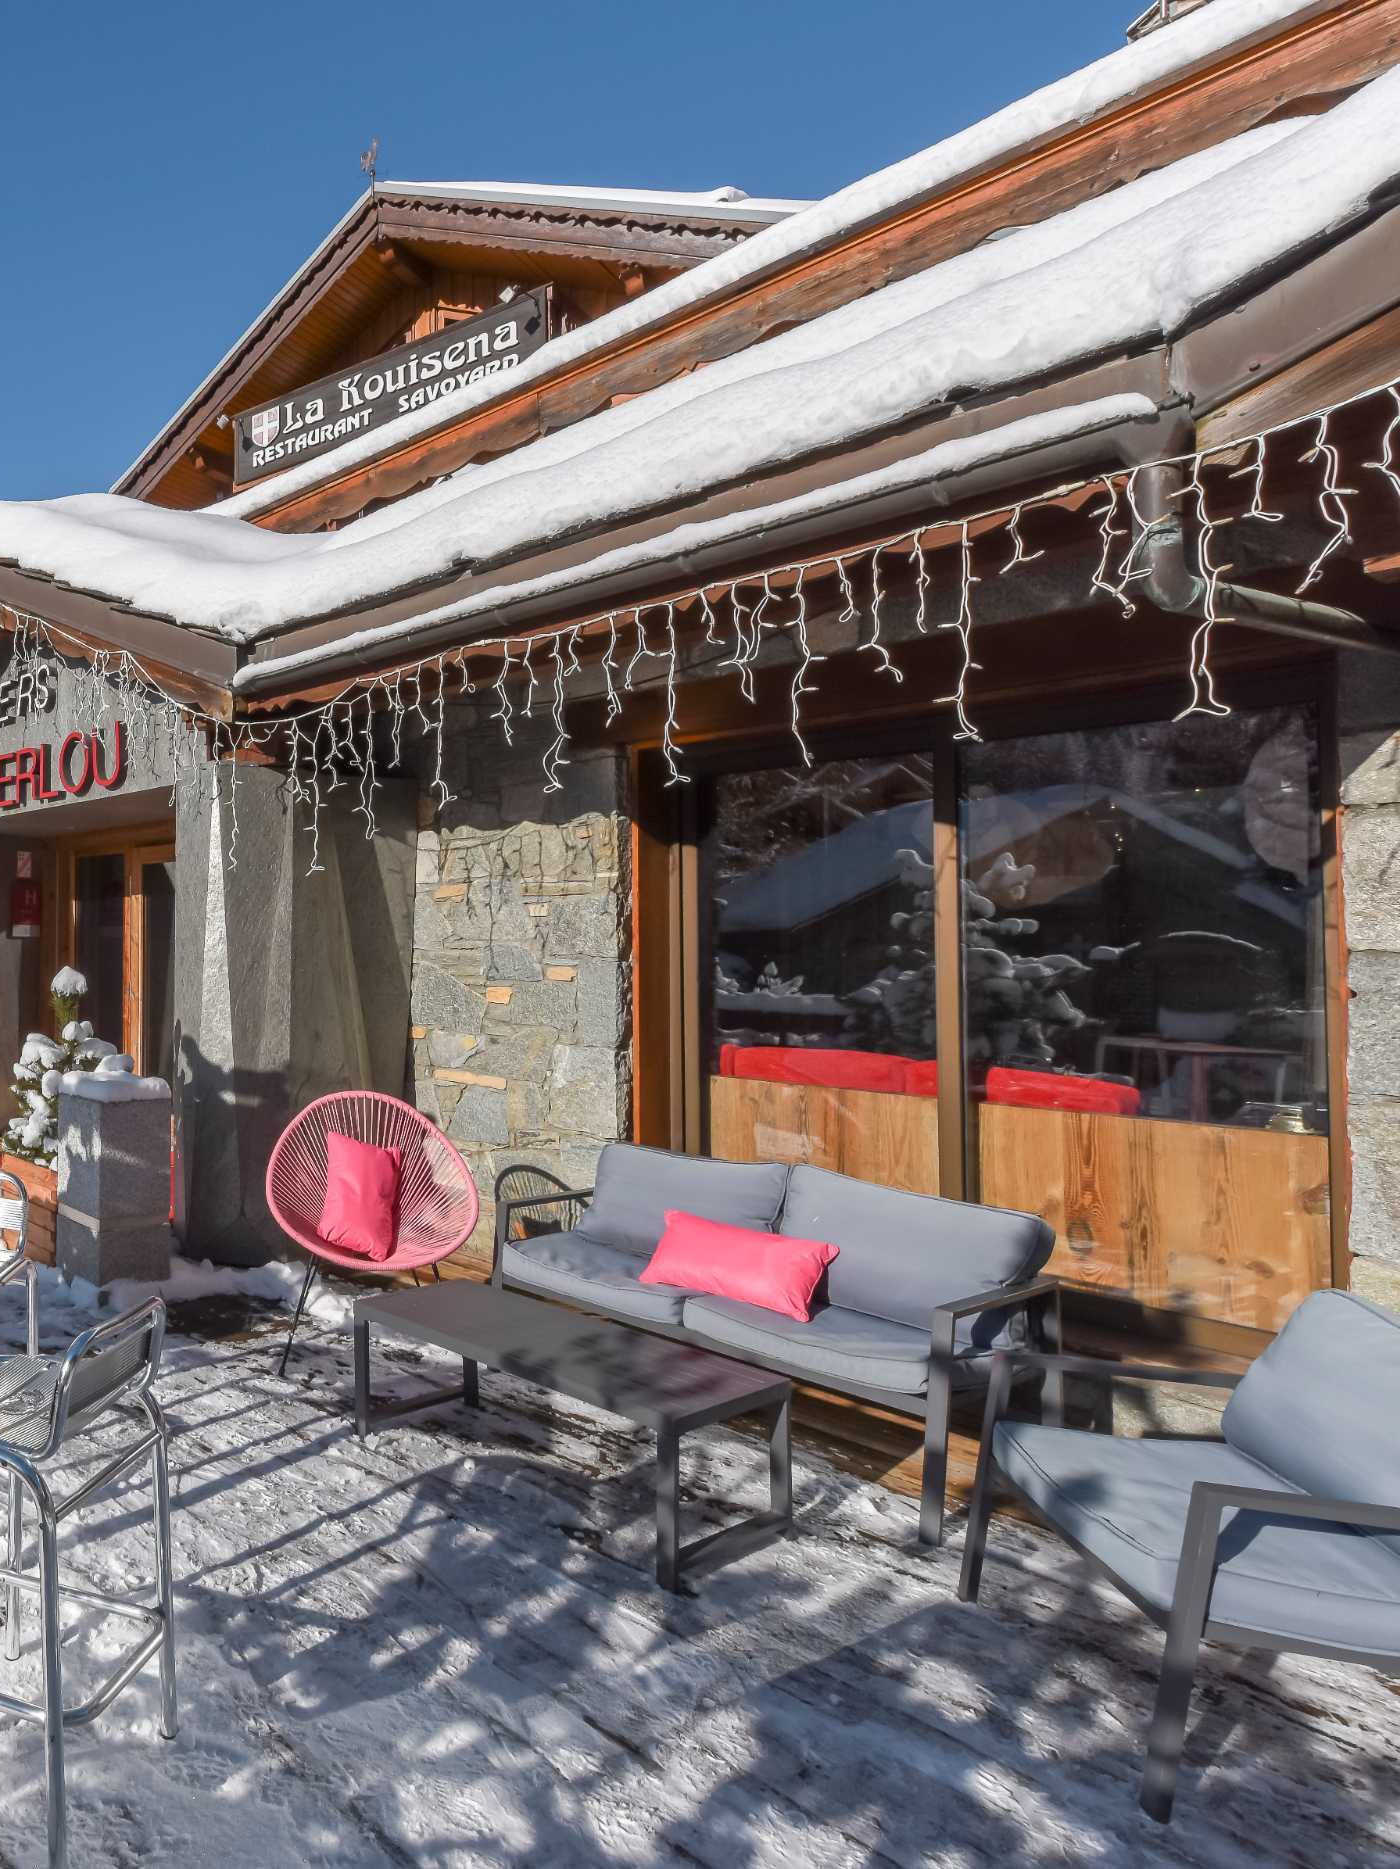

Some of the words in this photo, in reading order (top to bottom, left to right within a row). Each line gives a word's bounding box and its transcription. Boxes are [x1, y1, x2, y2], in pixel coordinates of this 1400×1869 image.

[283, 398, 325, 434] La
[338, 321, 519, 412] Kouisena
[252, 408, 373, 468] RESTAURANT
